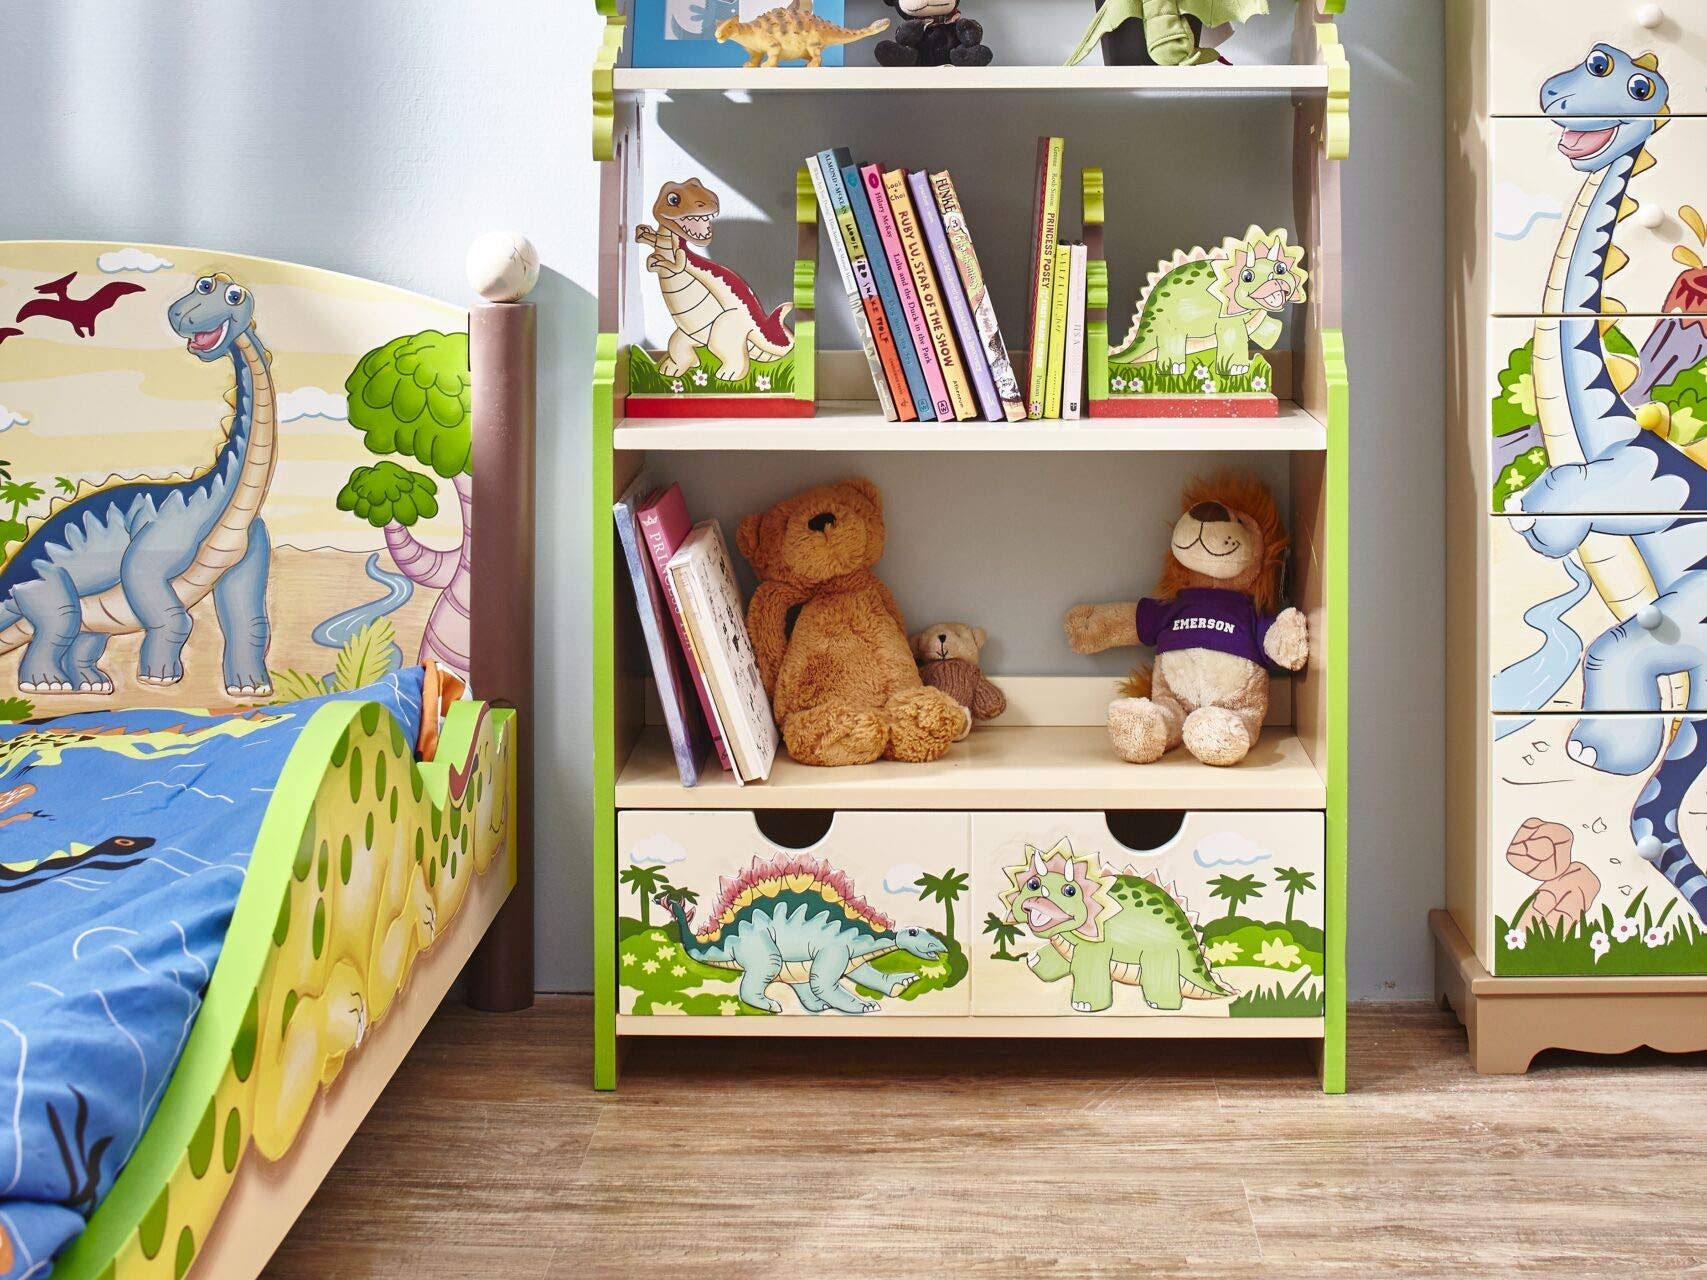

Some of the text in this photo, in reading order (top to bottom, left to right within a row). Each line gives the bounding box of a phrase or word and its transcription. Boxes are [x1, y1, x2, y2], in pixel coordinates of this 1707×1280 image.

[825, 153, 837, 183] ALMOND
[935, 178, 956, 213] FUNKE
[875, 193, 892, 239] Hilary McKay
[950, 219, 958, 228] 3
[1043, 212, 1055, 255] PRINCESS
[899, 210, 952, 367] RUBY LU, STAR OF THE SHOW
[1041, 258, 1051, 288] POSEY
[894, 253, 902, 271] Lulu
[909, 302, 918, 322] Duck
[916, 323, 921, 331] in
[923, 346, 931, 364] Park
[953, 380, 964, 408] Atheneum
[1172, 617, 1235, 634] EMERSON
